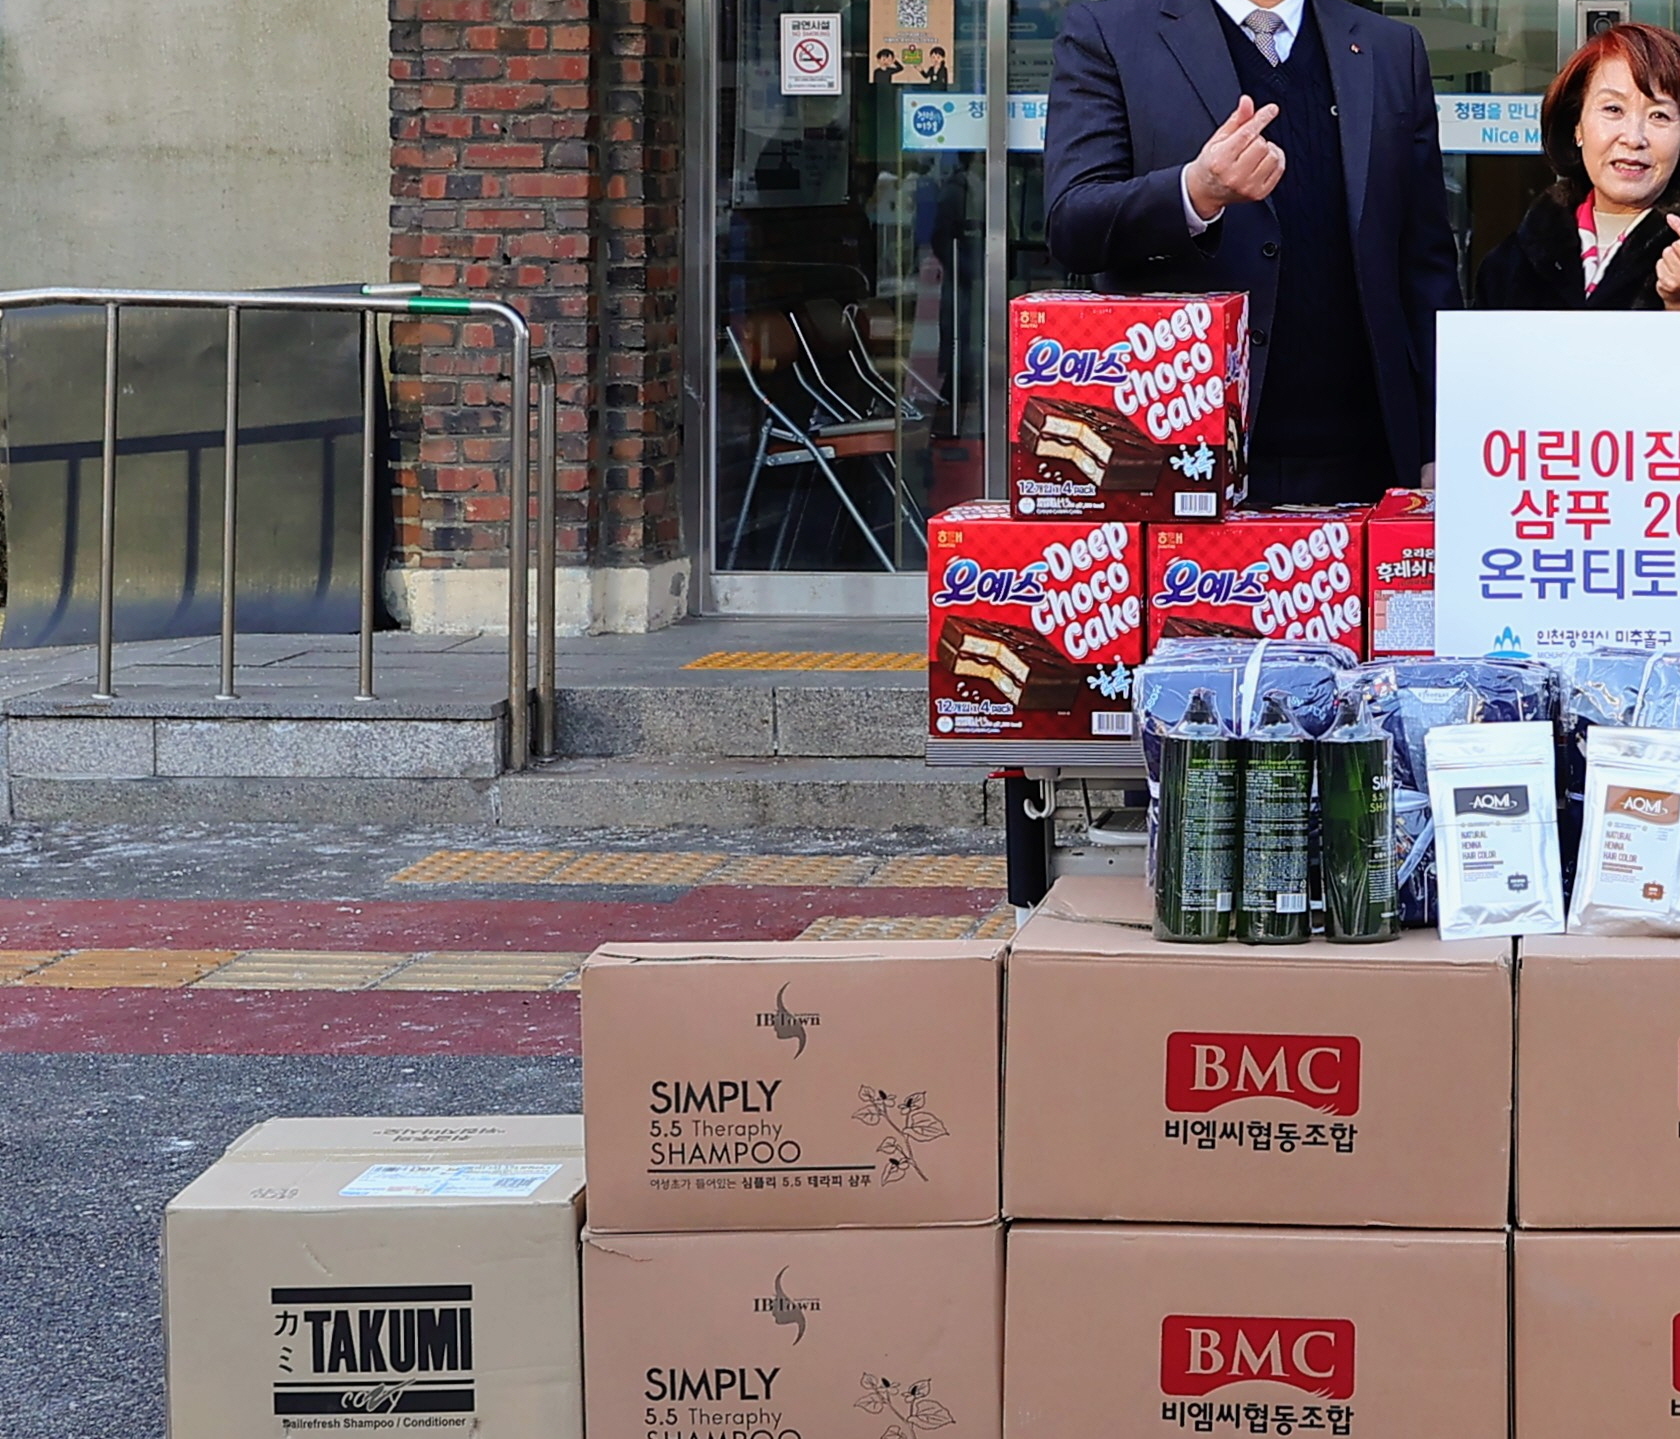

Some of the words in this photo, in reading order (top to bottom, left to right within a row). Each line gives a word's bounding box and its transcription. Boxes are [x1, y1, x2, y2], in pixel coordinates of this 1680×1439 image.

[792, 20, 830, 30] 금연시설
[1454, 102, 1502, 120] 청렴을
[1482, 127, 1519, 143] Nice
[1126, 302, 1212, 362] Deep
[1015, 336, 1132, 388] 오예스
[1510, 489, 1611, 541] 샴푸
[1042, 522, 1129, 581] Deep
[1264, 522, 1350, 581] Deep
[933, 557, 1049, 607] 오예스
[1152, 558, 1270, 608] 오예스
[1376, 560, 1426, 582] 후레쉬
[1537, 628, 1609, 648] 인천광역시
[1615, 629, 1672, 649] 미추홀구
[1461, 830, 1487, 839] NATURAL
[1462, 841, 1482, 849] HENNA
[1604, 841, 1624, 851] HENNA
[1605, 830, 1632, 841] NATURAL
[1462, 851, 1476, 860] HAIR
[1478, 850, 1496, 859] COLOR
[1603, 851, 1617, 861] HAIR
[1618, 853, 1637, 863] COLOR
[1189, 1043, 1342, 1095] BMC
[649, 1080, 782, 1114] SIMPLY
[650, 1120, 682, 1137] 5.5
[692, 1119, 783, 1142] Theraphy
[1164, 1119, 1358, 1153] 비엠씨협동조합
[650, 1140, 802, 1165] SHAMPOO
[650, 1178, 691, 1190] 어성초가
[696, 1178, 737, 1190] 들어있는
[741, 1176, 776, 1190] 심플리
[782, 1176, 802, 1187] 5.5
[807, 1175, 843, 1188] 테라피
[848, 1175, 871, 1187] 샴푸
[304, 1307, 472, 1374] TAKUMI
[1185, 1327, 1337, 1378] BMC
[644, 1367, 781, 1401] SIMPLY
[343, 1418, 395, 1431] Shampoo
[403, 1416, 466, 1428] Conditioner
[645, 1408, 678, 1426] 5.5
[688, 1407, 782, 1431] Theraphy
[1161, 1401, 1355, 1436] 비엠씨협동조합
